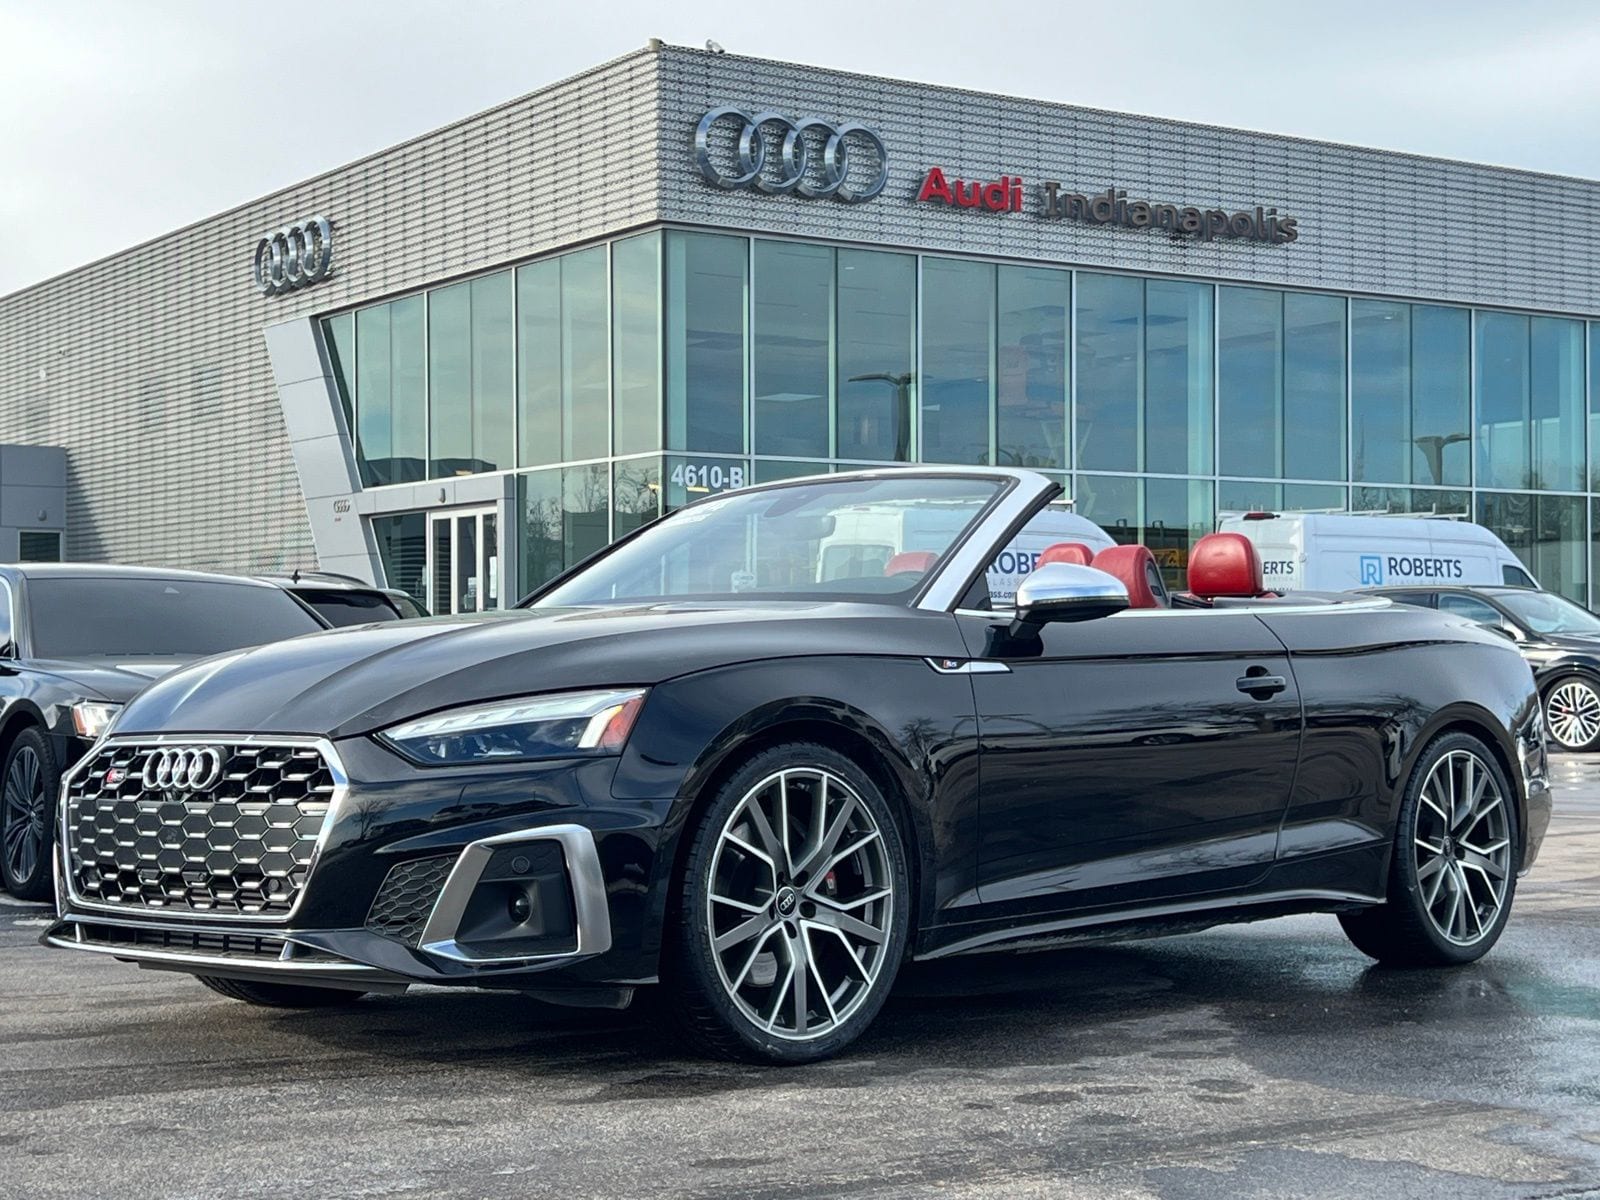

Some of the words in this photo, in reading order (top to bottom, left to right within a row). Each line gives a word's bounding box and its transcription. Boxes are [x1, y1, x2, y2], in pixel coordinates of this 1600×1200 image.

[917, 167, 1022, 213] Audi
[1042, 181, 1298, 244] Indianapolis
[671, 464, 744, 488] 4610-B
[1263, 560, 1294, 575] ERTS
[1387, 556, 1463, 578] ROBERTS
